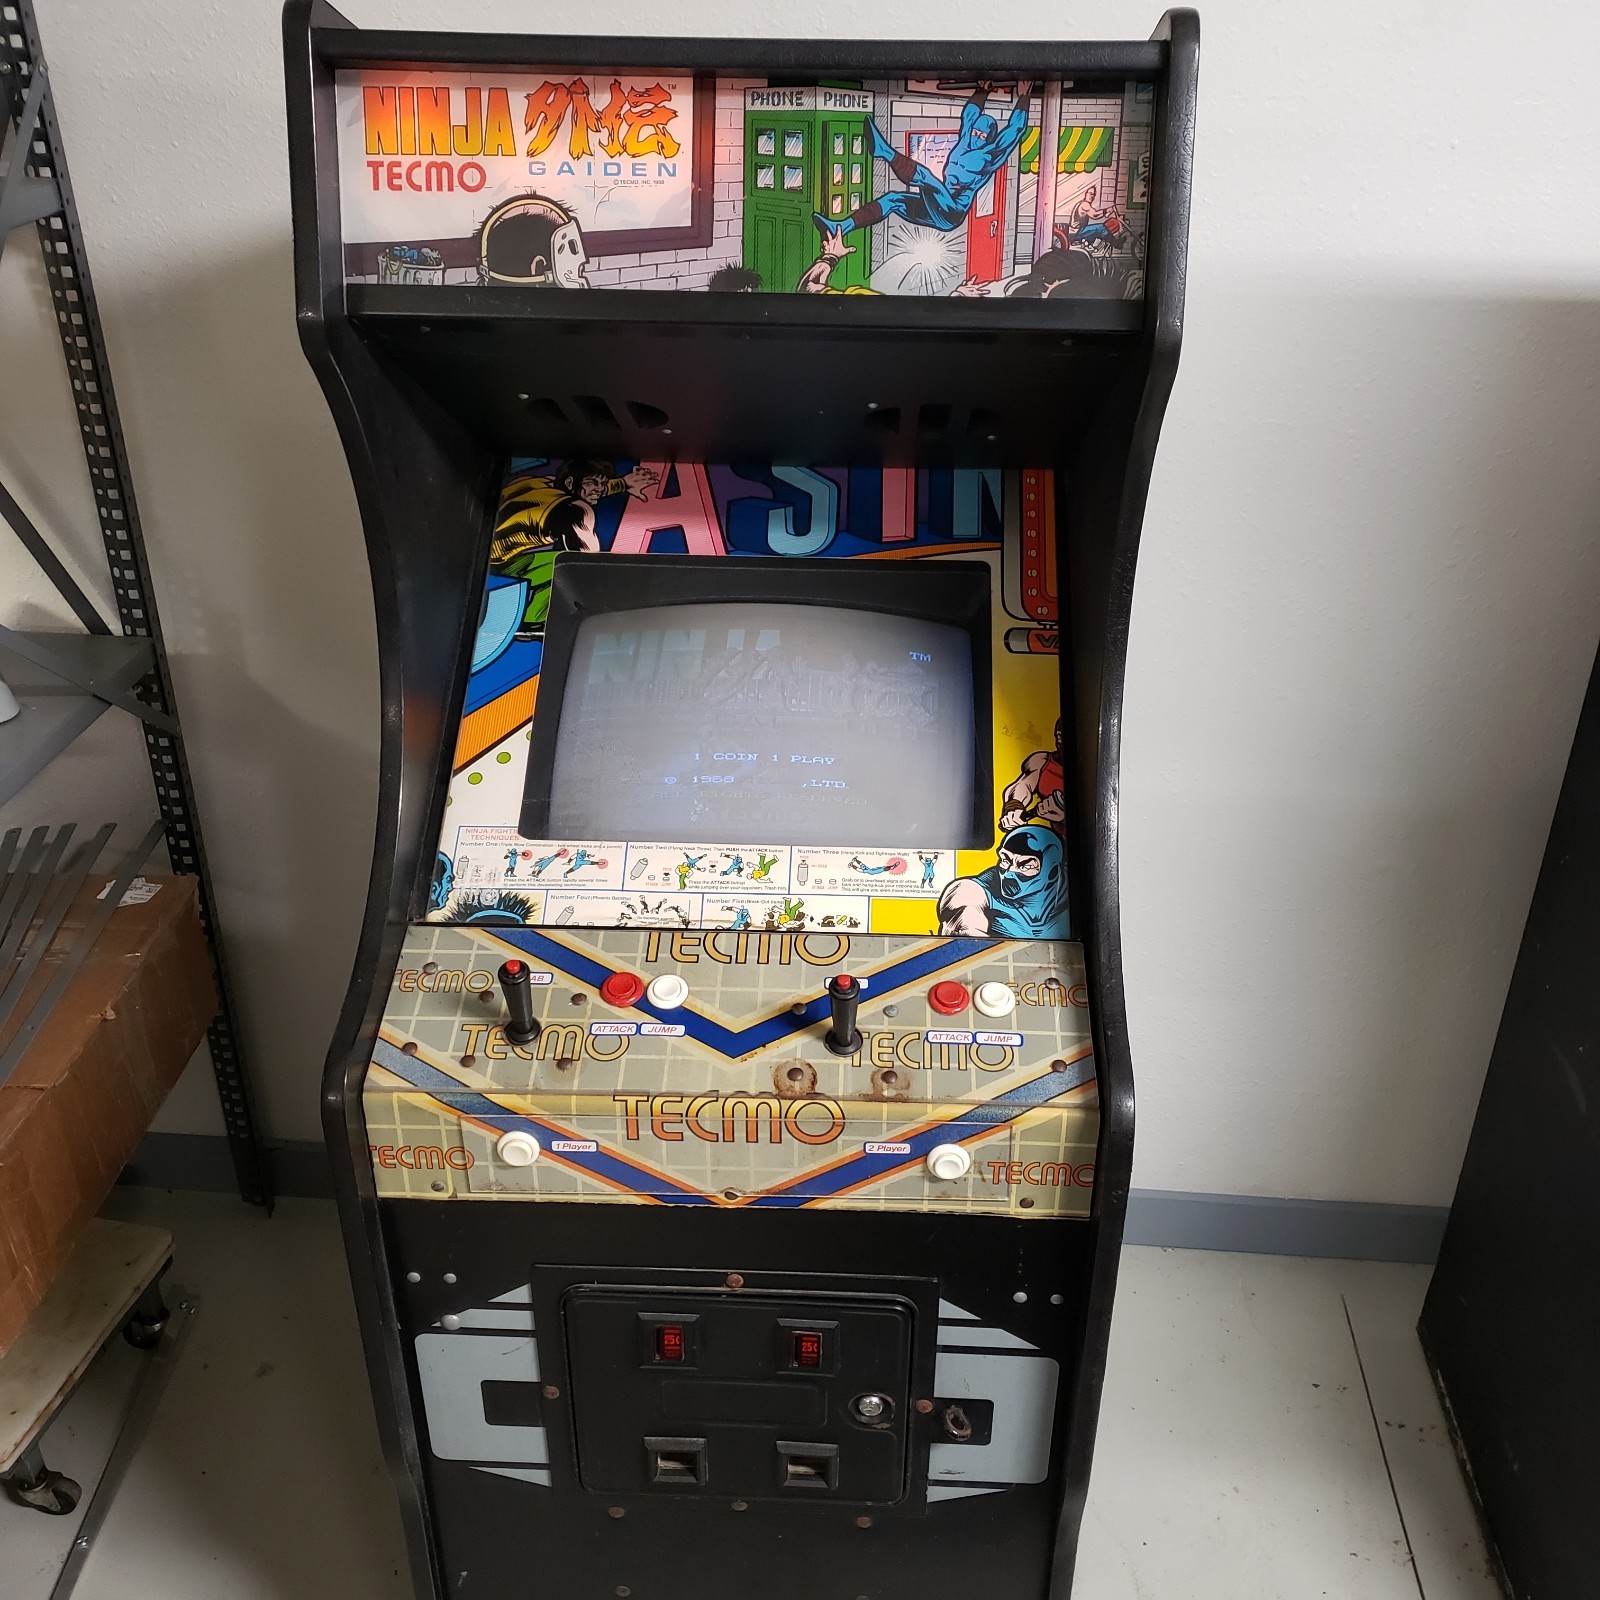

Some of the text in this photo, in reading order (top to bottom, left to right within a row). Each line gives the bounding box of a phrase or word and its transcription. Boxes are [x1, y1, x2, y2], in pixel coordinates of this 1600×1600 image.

[750, 91, 804, 107] PHONE
[823, 91, 868, 108] PHONE
[363, 86, 517, 156] NINJA
[528, 161, 677, 177] GAIDEN
[366, 160, 487, 192] TECMO
[909, 650, 931, 663] TM
[694, 752, 835, 765] 1 COIN 1 PLAY
[595, 1025, 634, 1034] ATTACK
[648, 1026, 678, 1034] JUMP
[931, 1034, 970, 1042] ATTACK
[984, 1034, 1013, 1042] JUMP
[613, 1092, 846, 1145] TECMO
[563, 1143, 592, 1152] Player
[868, 1144, 907, 1153] 2 Player
[664, 1334, 680, 1345] 25¢
[802, 1342, 818, 1353] 25¢
